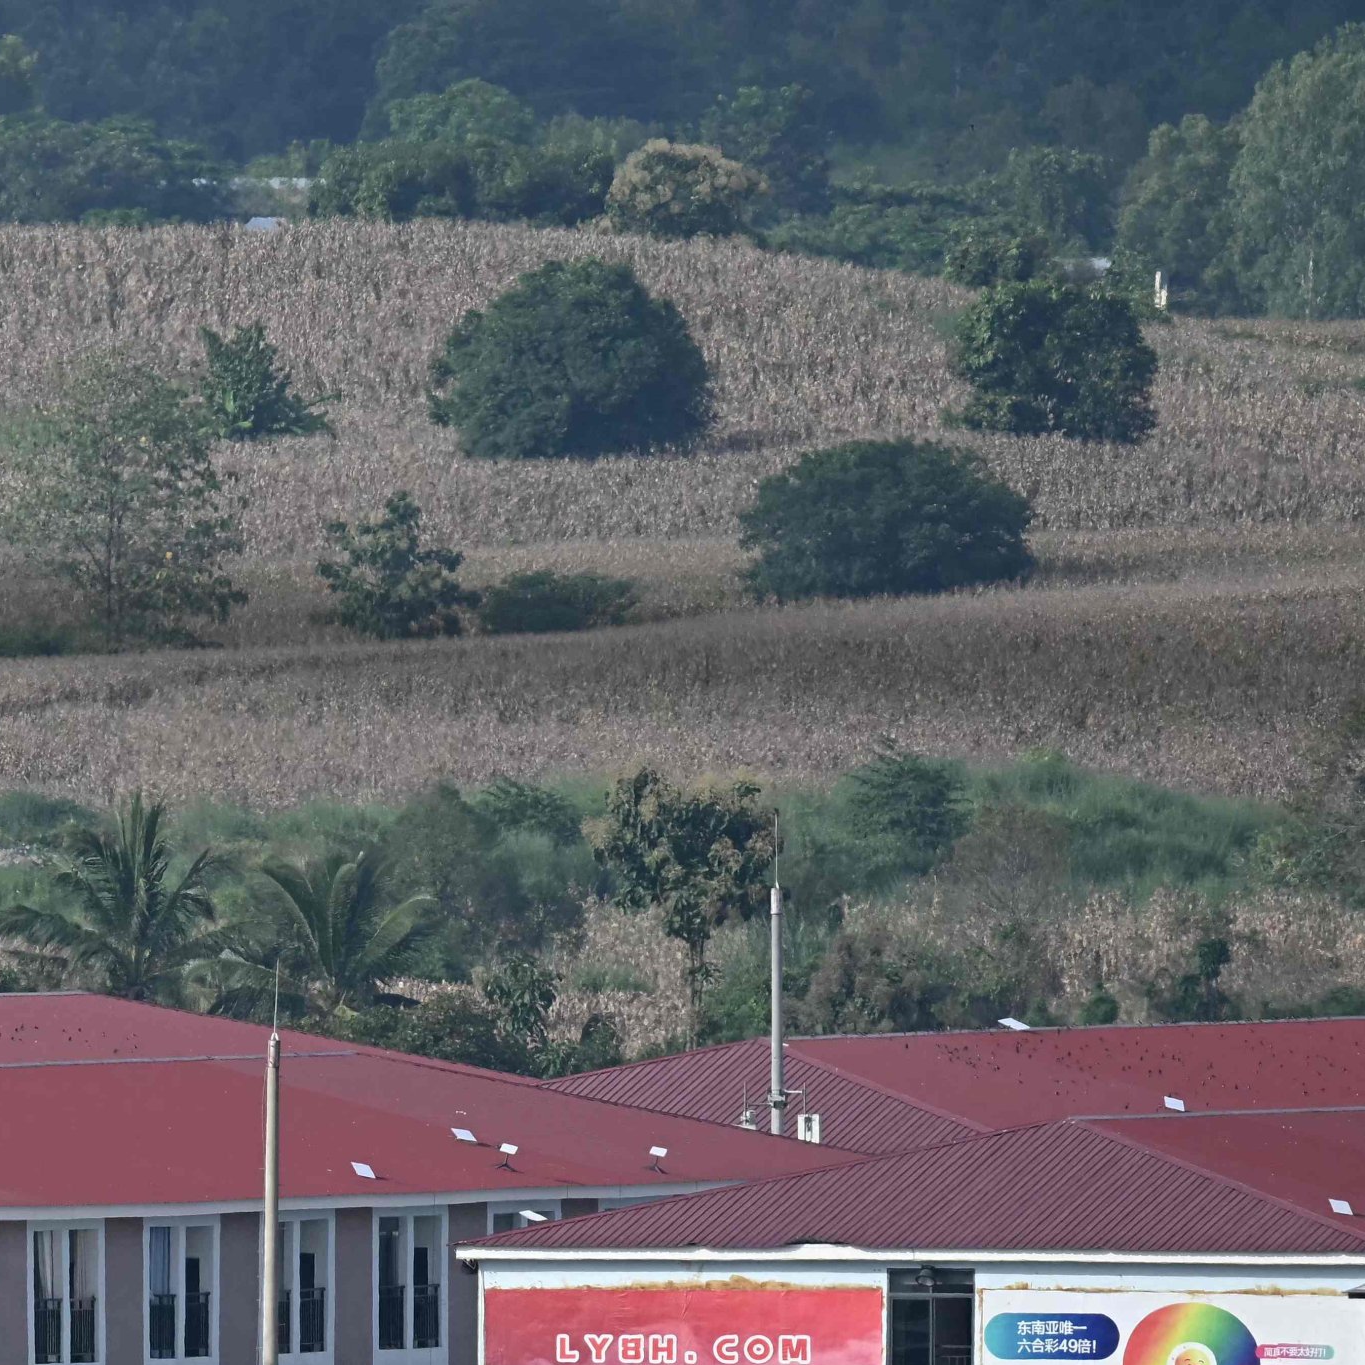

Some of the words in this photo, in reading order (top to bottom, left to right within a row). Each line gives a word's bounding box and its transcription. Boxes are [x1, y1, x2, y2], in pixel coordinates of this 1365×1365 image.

[1017, 1320, 1087, 1336] 东南亚唯一
[556, 1333, 811, 1364] LY8H.COM
[1017, 1338, 1097, 1354] 六合彩49倍!
